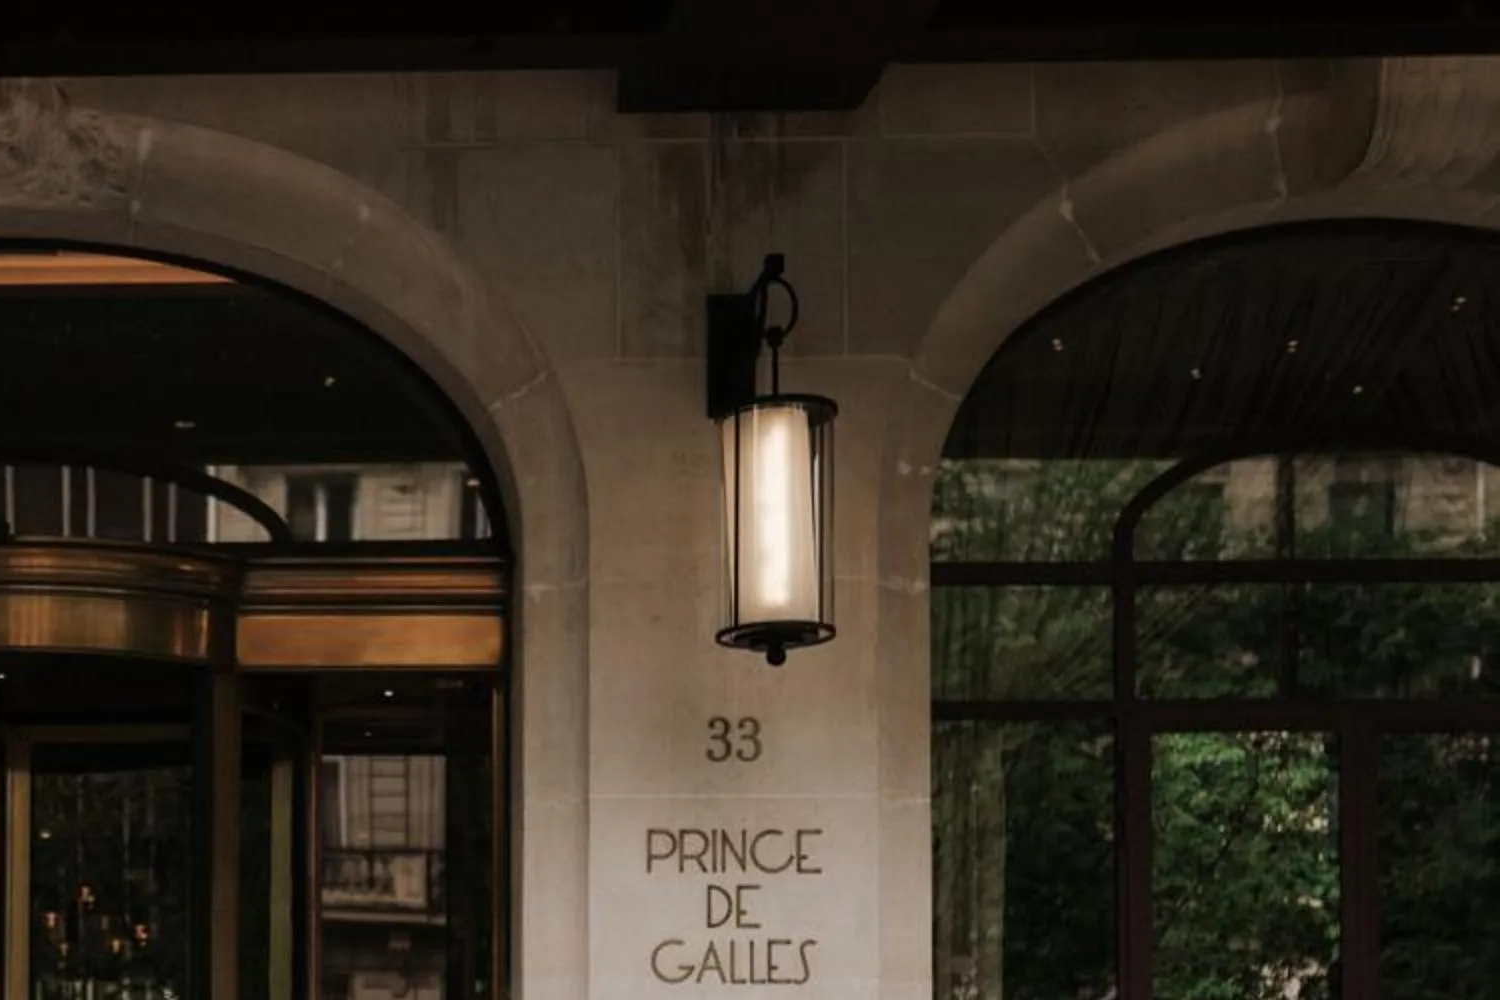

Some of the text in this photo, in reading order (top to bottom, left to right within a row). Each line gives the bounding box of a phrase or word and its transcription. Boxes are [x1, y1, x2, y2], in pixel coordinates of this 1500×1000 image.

[706, 716, 763, 762] 33
[646, 829, 823, 873] PRINCE
[706, 884, 761, 929] DE
[651, 939, 818, 984] GALLES
